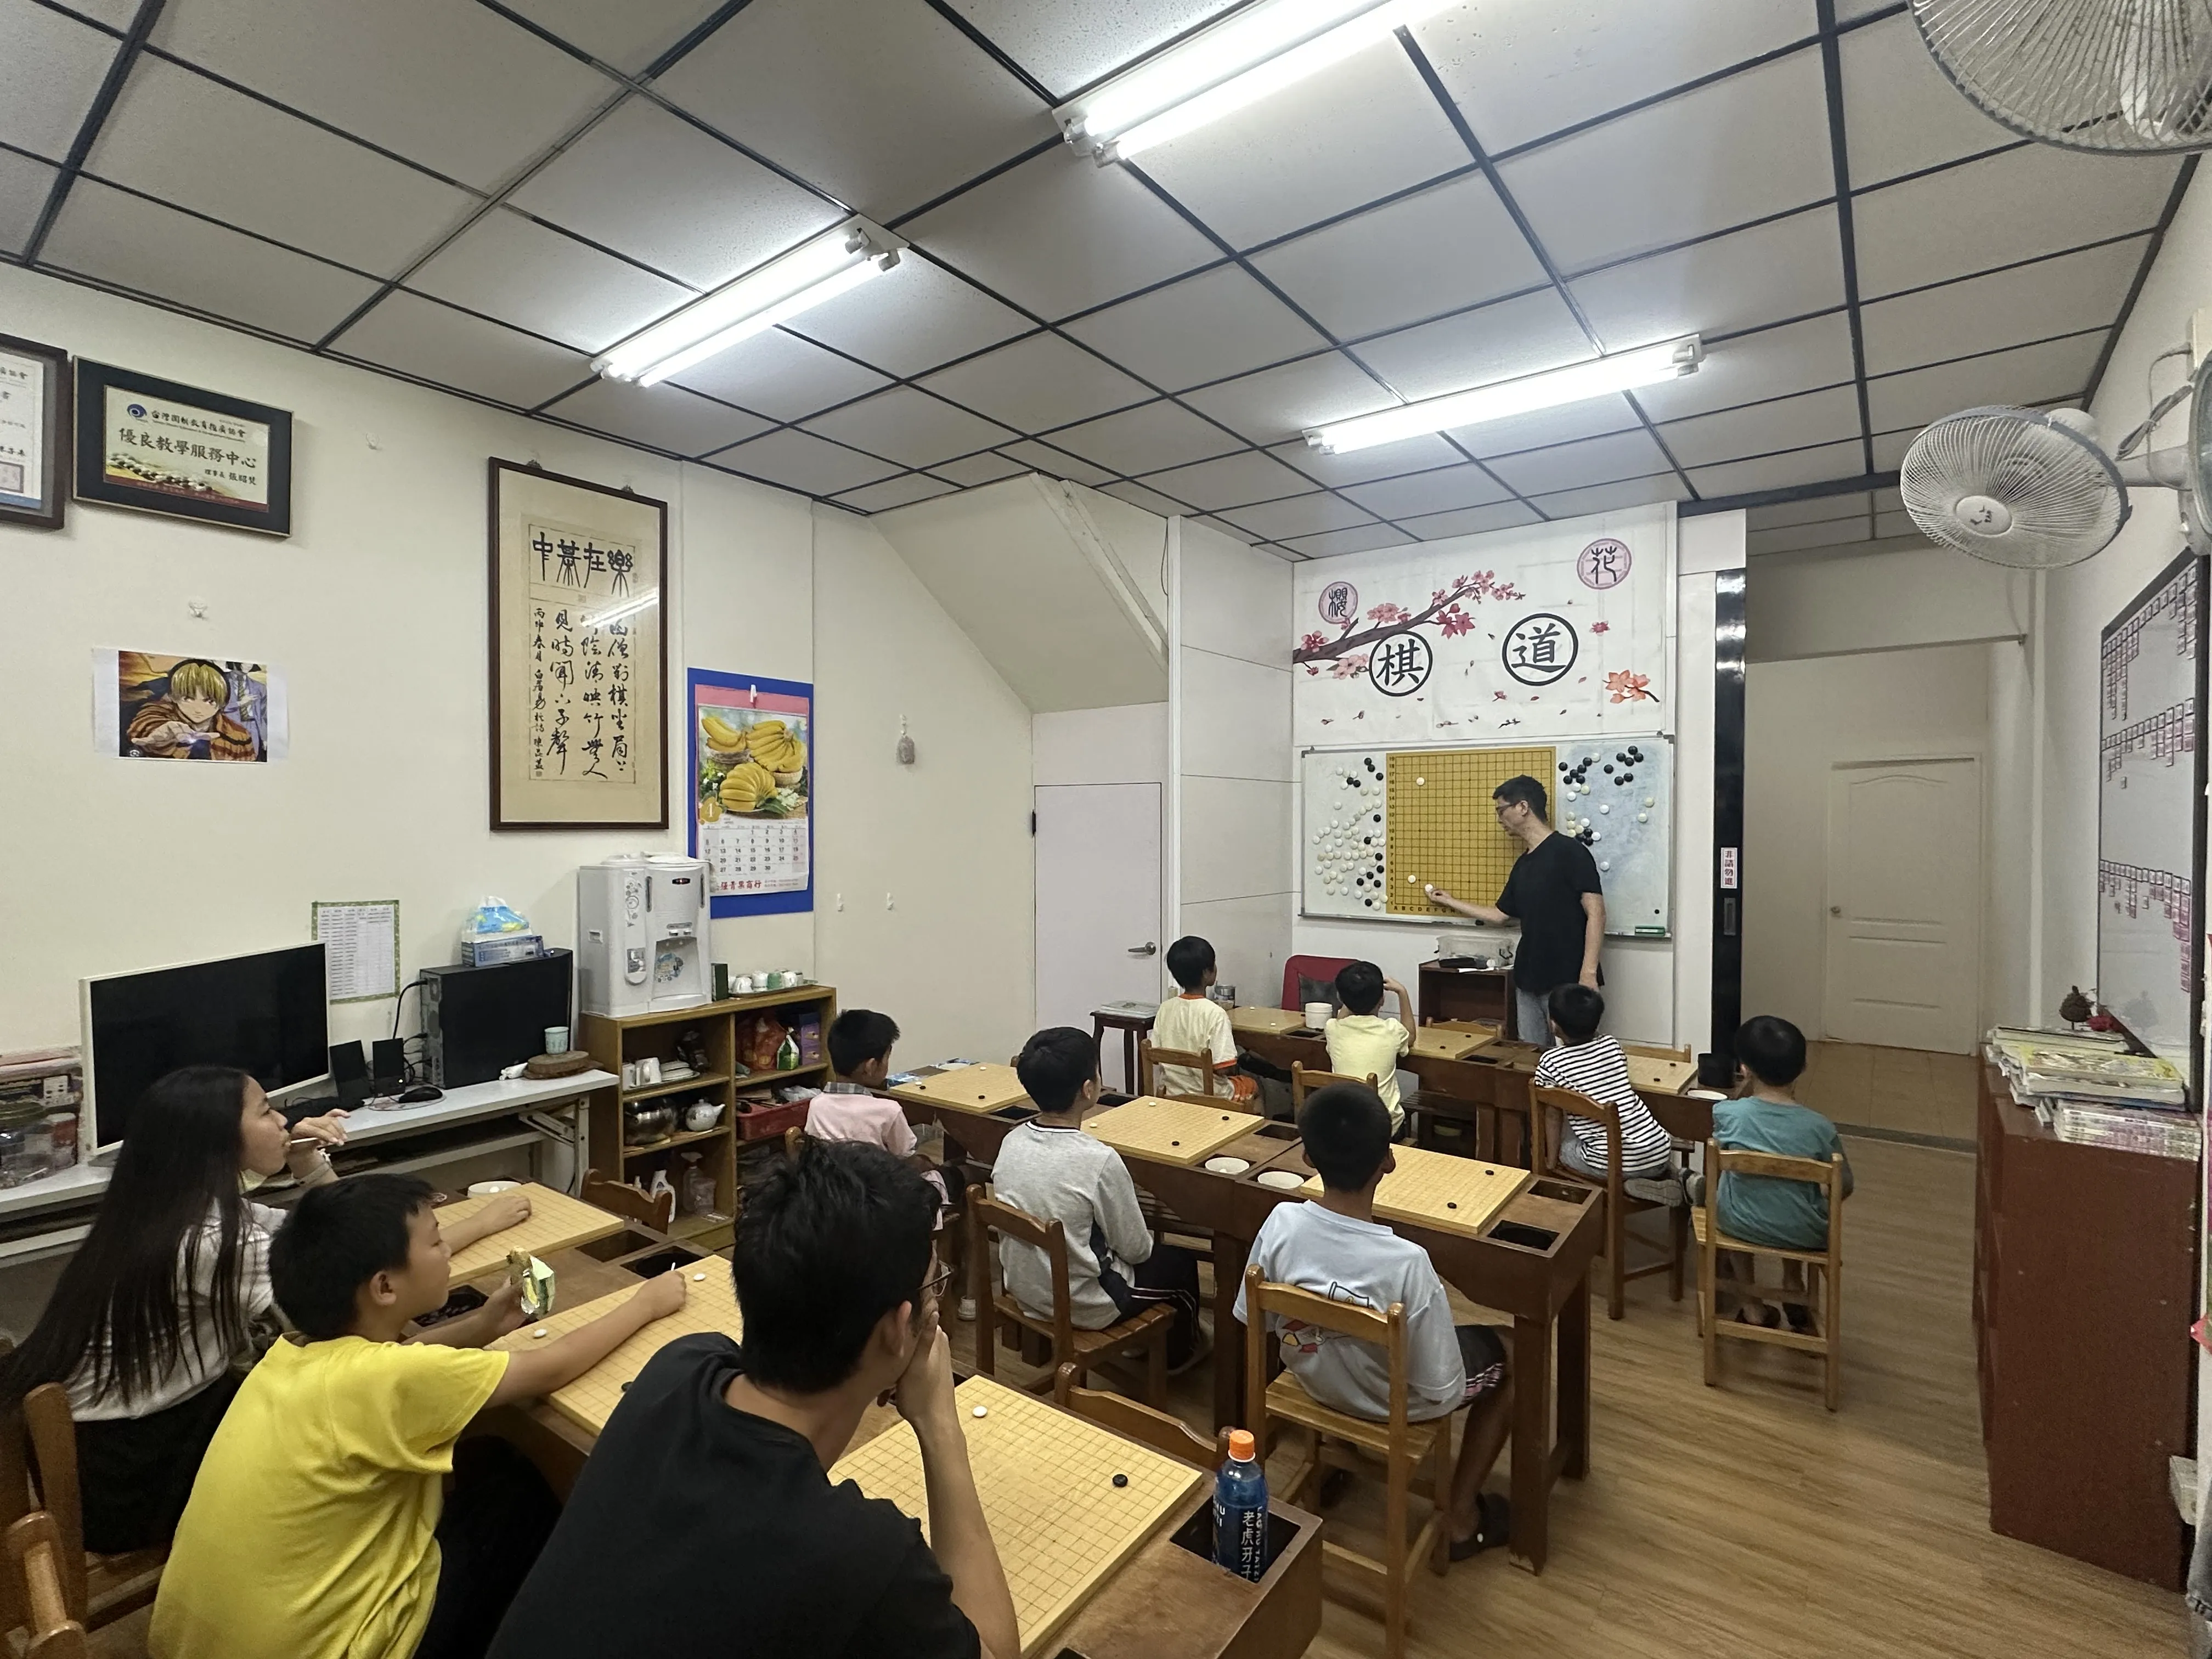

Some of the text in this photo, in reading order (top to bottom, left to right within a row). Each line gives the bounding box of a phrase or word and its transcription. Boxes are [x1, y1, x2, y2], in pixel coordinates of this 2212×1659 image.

[119, 428, 257, 468] 優良教學服務中心
[1328, 546, 1617, 617] 櫻 花
[1376, 623, 1567, 686] 棋 道
[705, 803, 713, 817] 4
[1241, 1511, 1255, 1580] 老虎牙子
